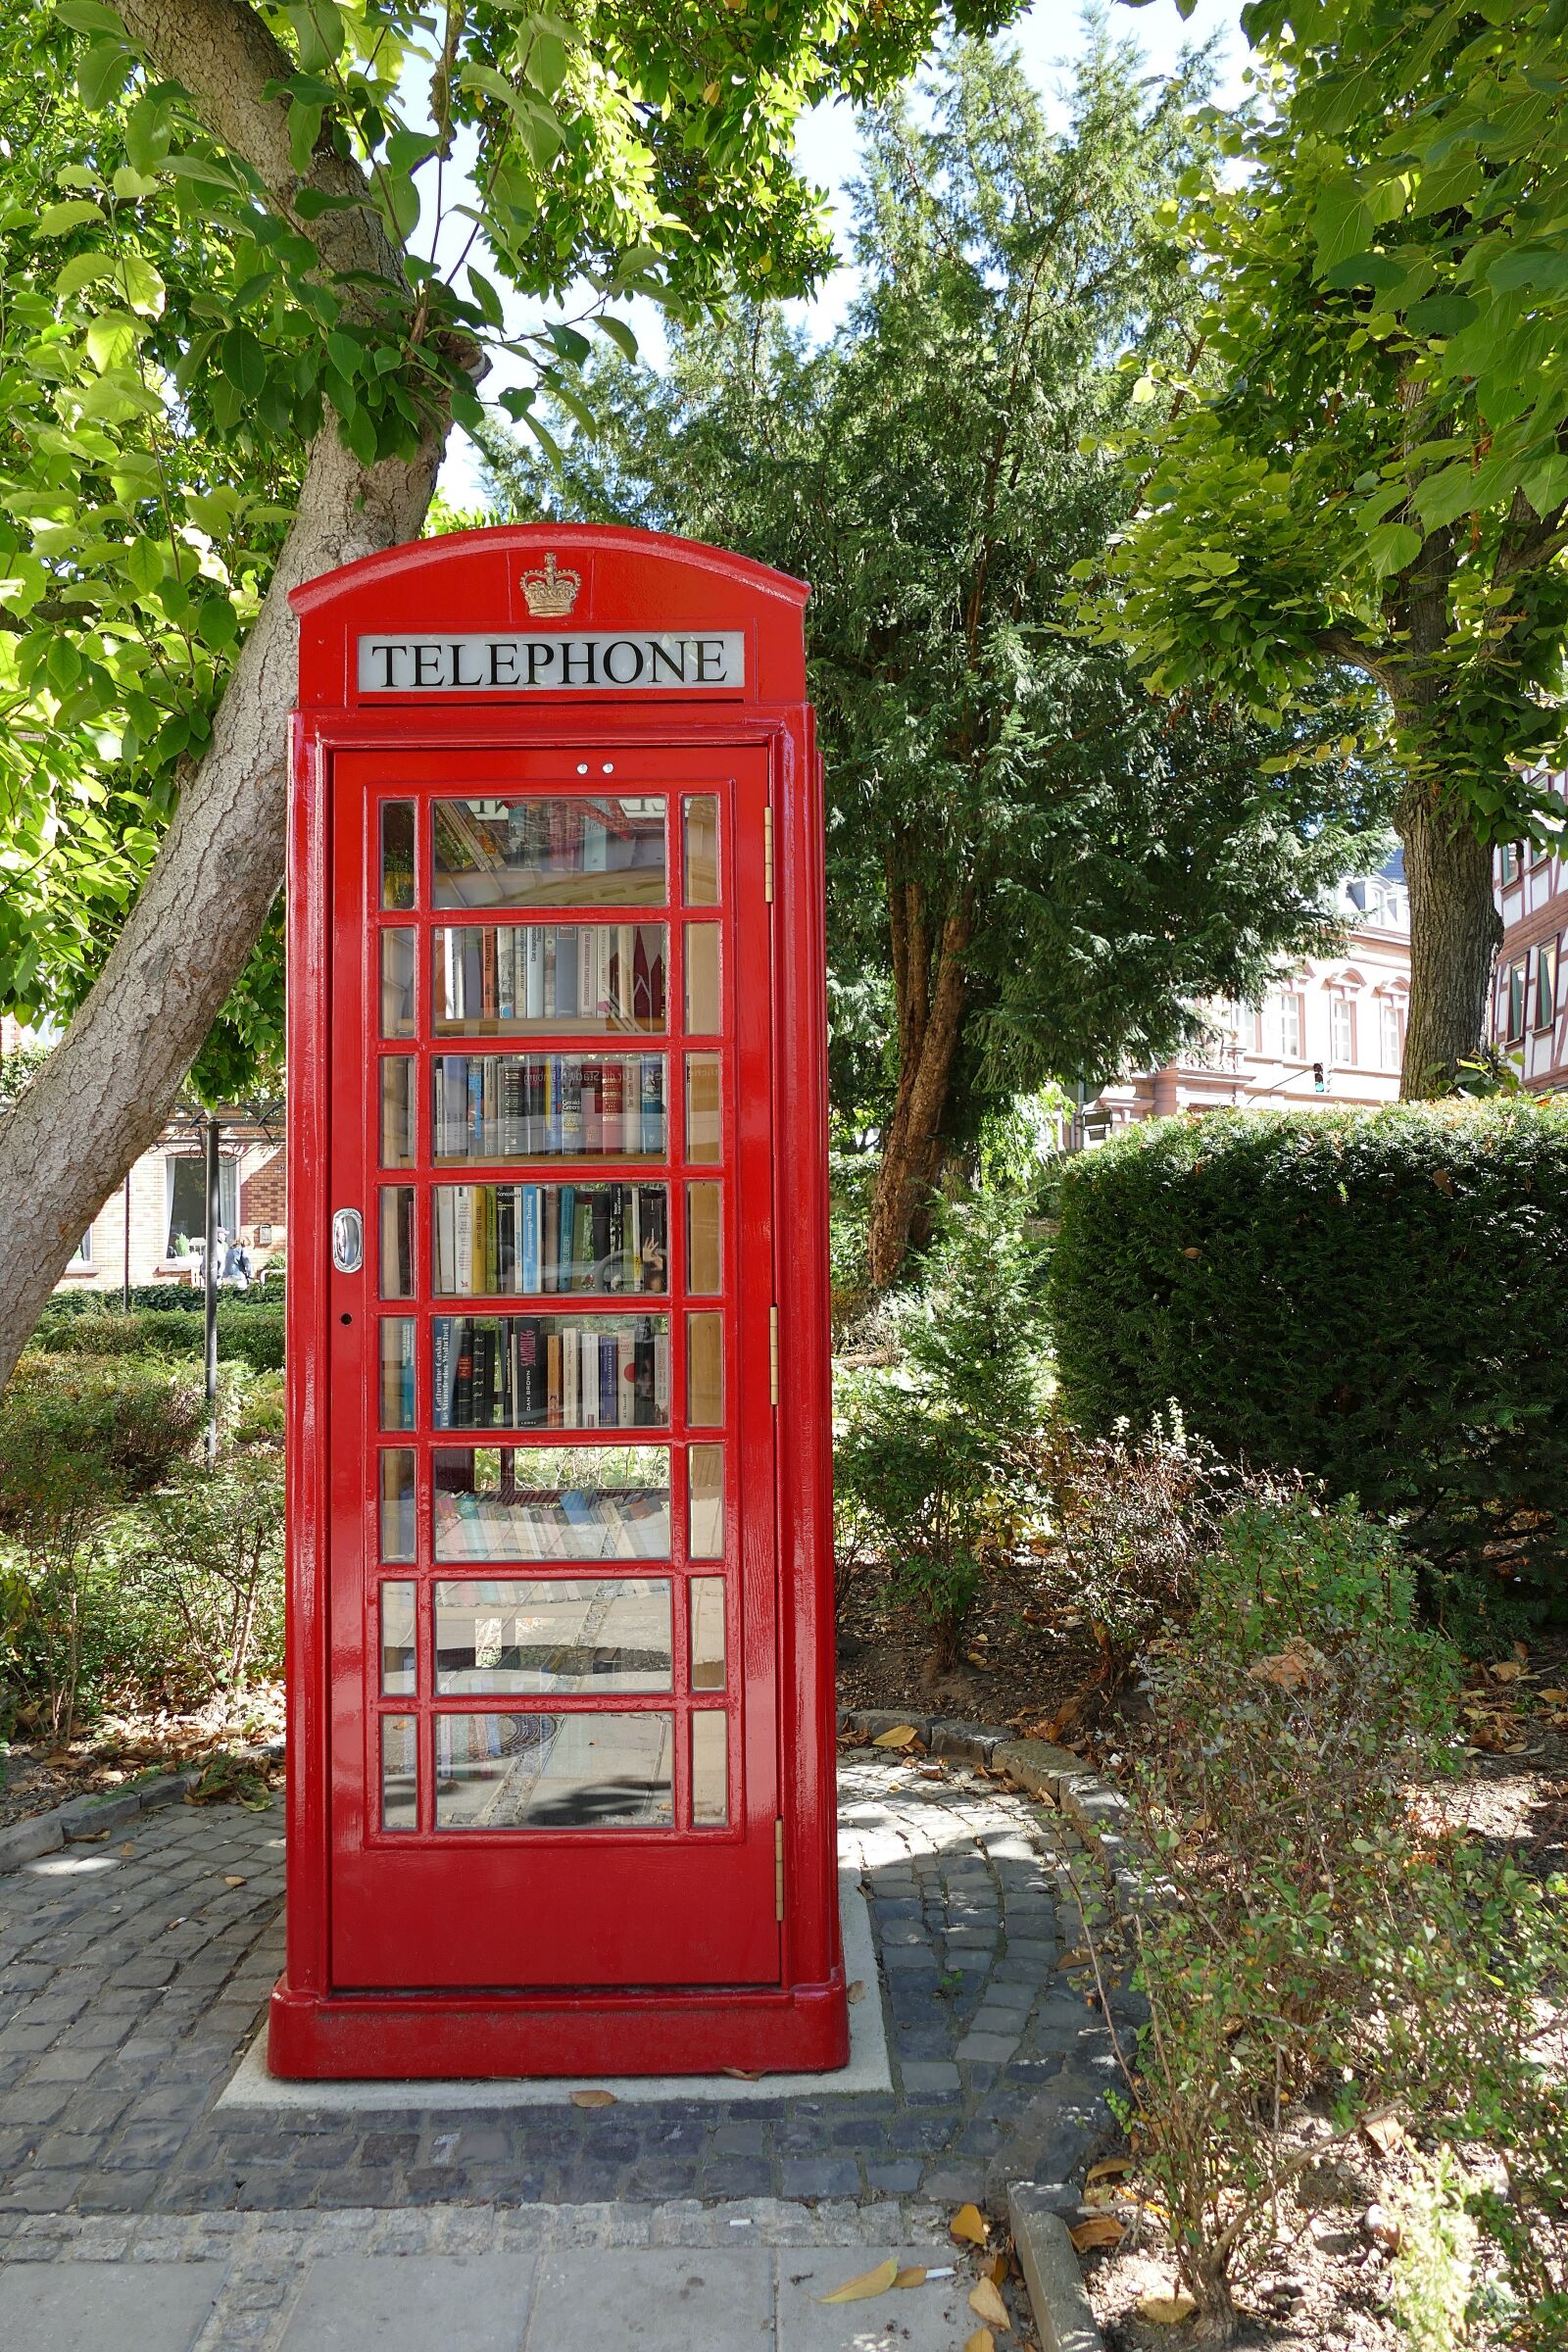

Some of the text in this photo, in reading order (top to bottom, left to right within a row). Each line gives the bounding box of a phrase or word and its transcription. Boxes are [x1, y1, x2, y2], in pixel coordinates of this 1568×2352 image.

[371, 640, 728, 688] TELEPHONE
[563, 1236, 571, 1269] NEUBER
[519, 1329, 536, 1367] SAKRILEG
